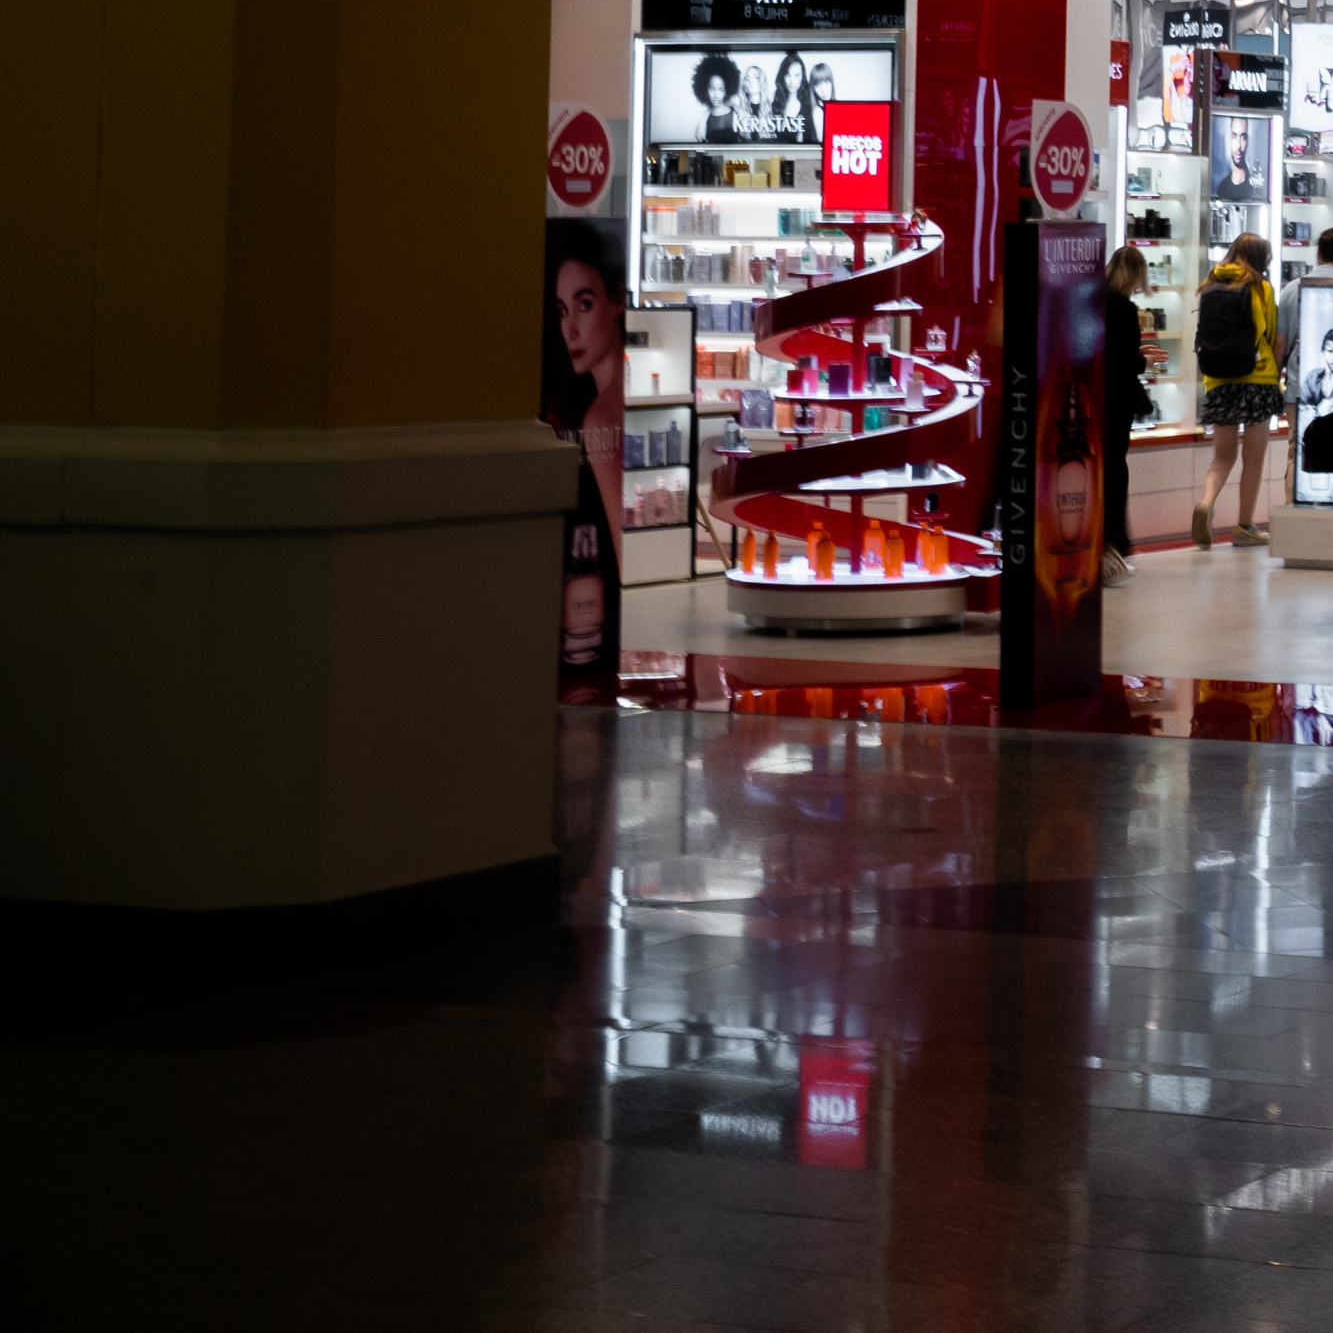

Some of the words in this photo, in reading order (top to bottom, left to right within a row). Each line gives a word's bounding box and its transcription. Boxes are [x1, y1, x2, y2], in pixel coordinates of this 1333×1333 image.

[832, 135, 883, 152] PREÇOS
[551, 143, 605, 176] -30%
[831, 149, 882, 175] HOT
[1040, 145, 1086, 178] -30%
[1050, 264, 1097, 274] GIVENCHY
[1008, 364, 1030, 566] GIVENCHY
